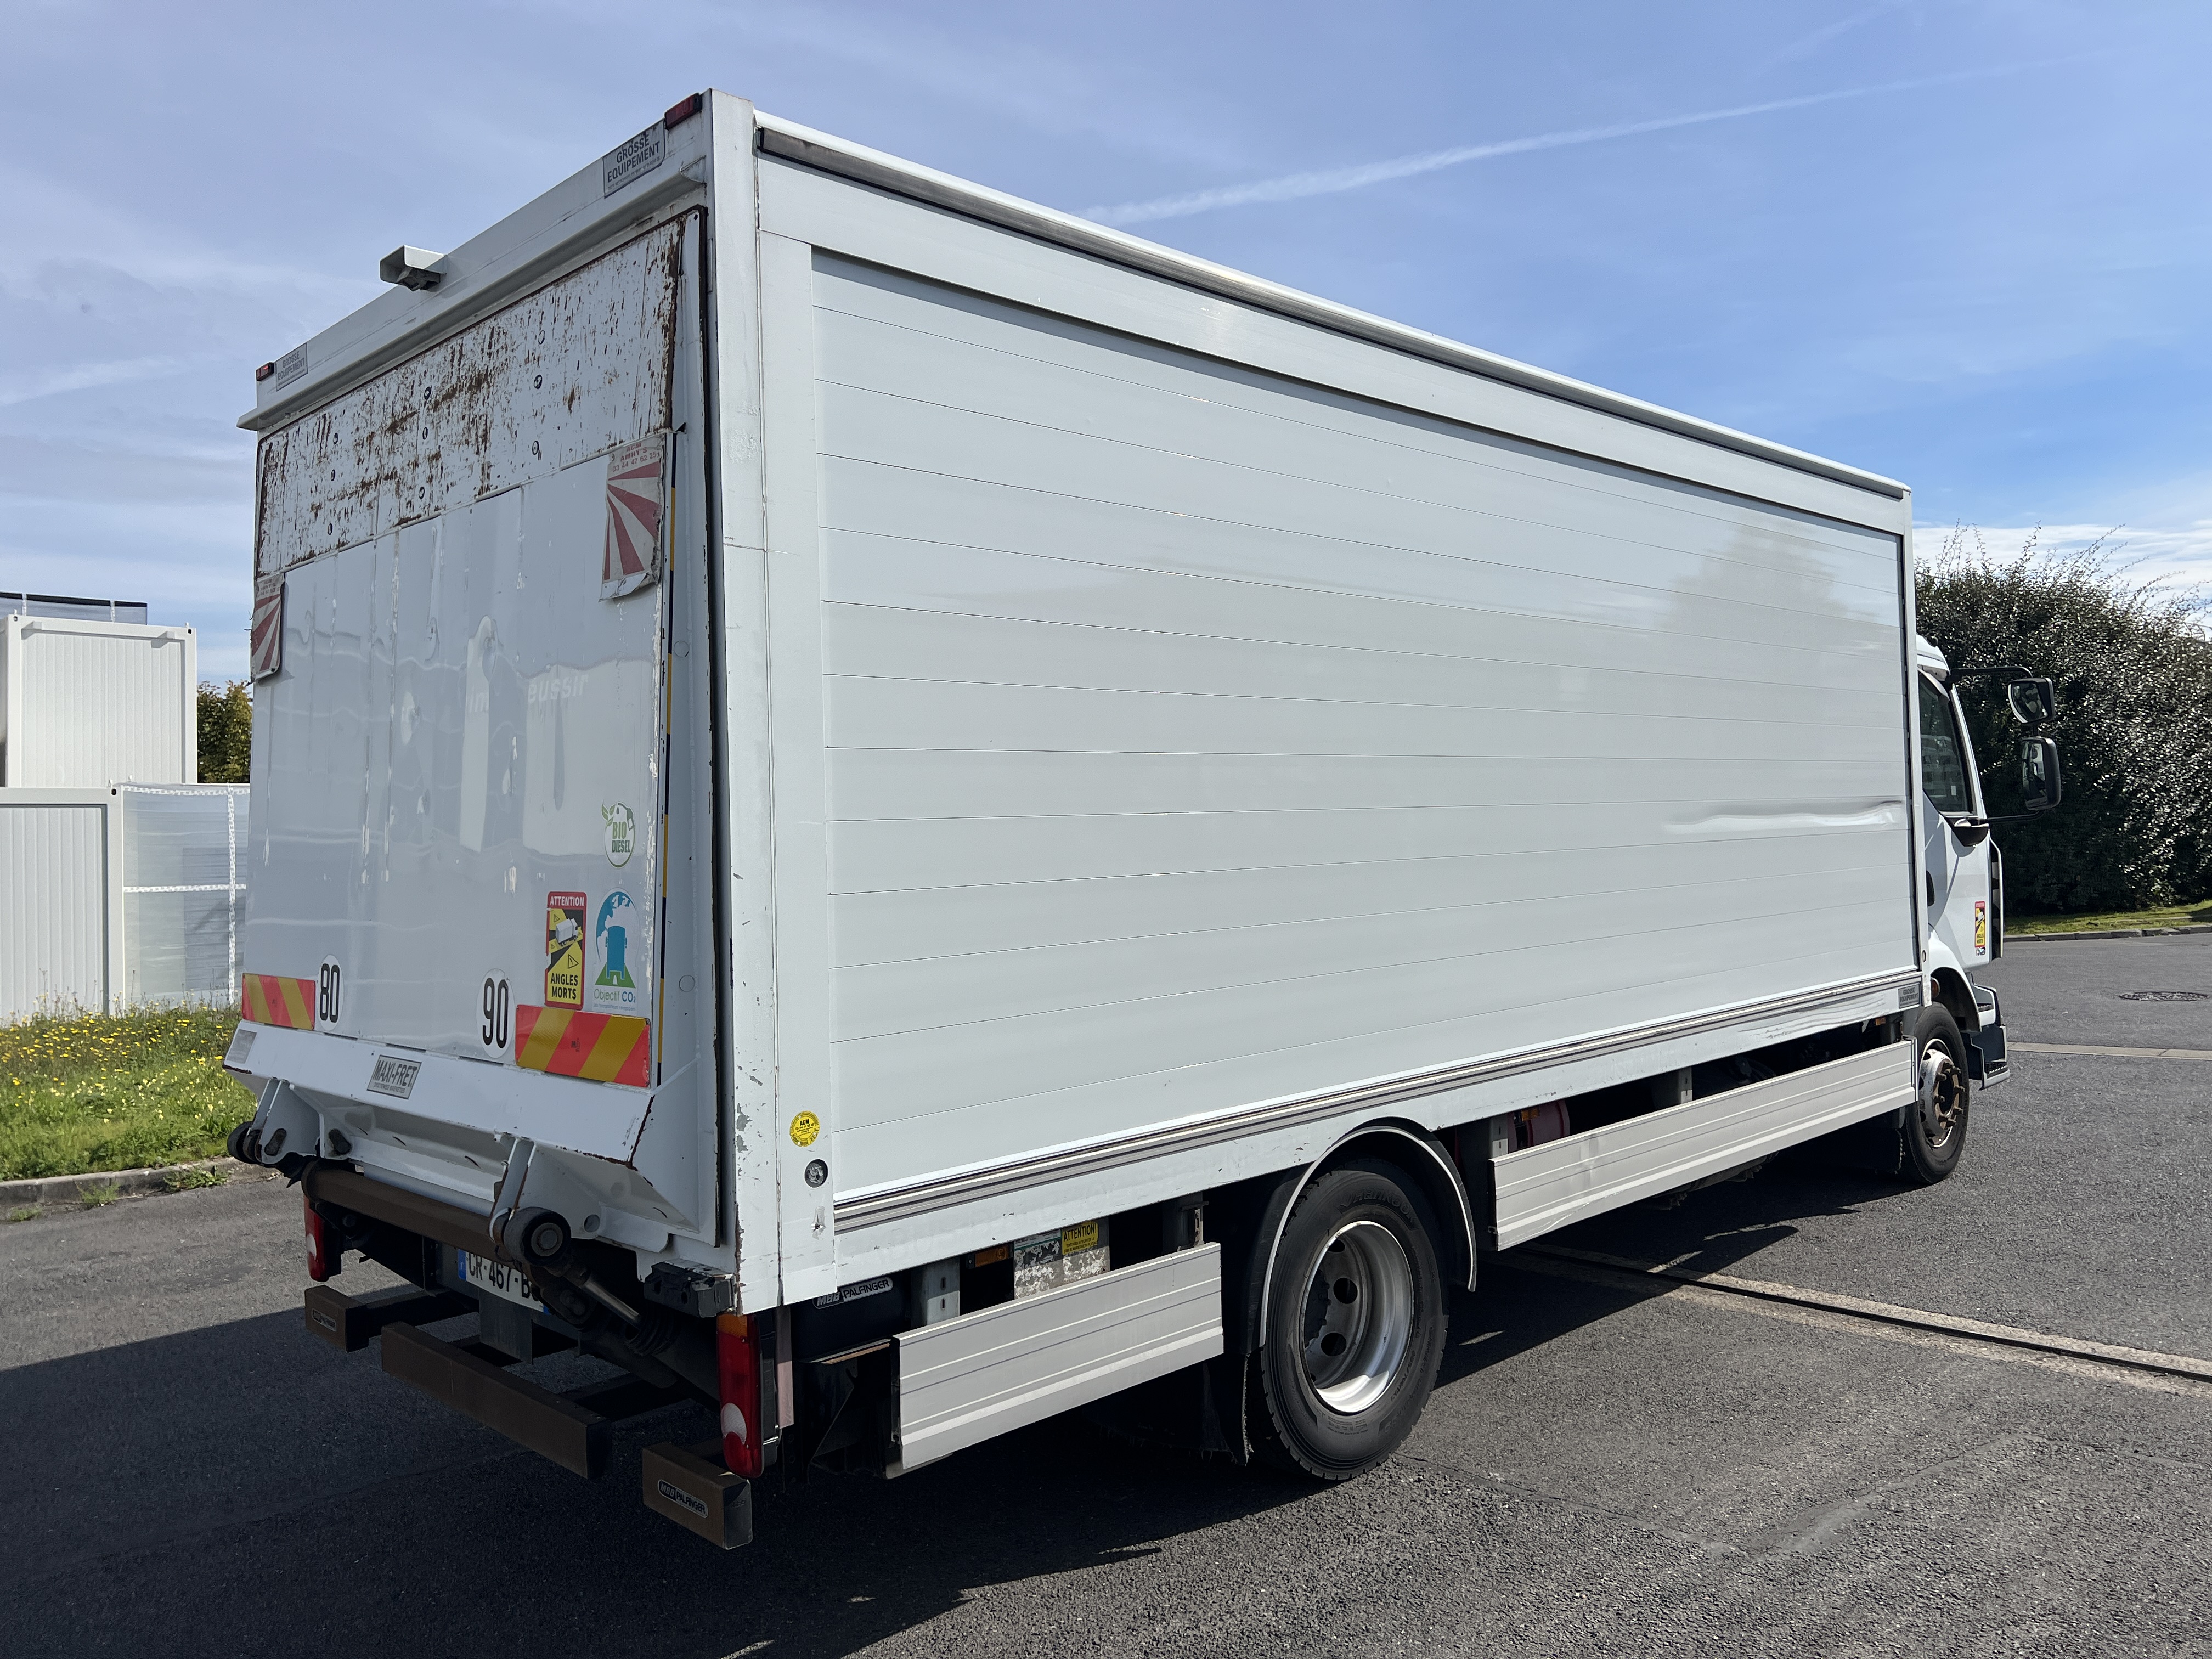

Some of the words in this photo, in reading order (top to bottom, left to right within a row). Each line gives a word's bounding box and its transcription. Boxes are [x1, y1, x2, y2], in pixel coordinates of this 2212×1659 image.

[617, 132, 649, 163] GROSSE
[607, 141, 660, 183] EQUIPEMENT
[278, 358, 305, 381] EQUIPEMENT
[282, 351, 300, 368] GROSSE
[627, 443, 641, 452] ACM
[612, 821, 627, 839] BIO
[612, 840, 630, 853] DIESEL
[550, 896, 584, 906] ATTENTION
[551, 973, 578, 986] ANGLES
[320, 963, 340, 1023] 80
[552, 986, 576, 1000] MORTS
[594, 989, 620, 1002] Objectif
[482, 978, 509, 1048] 90
[373, 1060, 417, 1087] MAXI-FRET
[1063, 1223, 1097, 1242] ATTENTION!
[469, 1252, 539, 1302] CR-467-B
[817, 1291, 840, 1306] MBB
[843, 1279, 890, 1299] PALFINGER
[660, 1483, 675, 1496] MBB
[676, 1491, 706, 1514] PALFINGER
